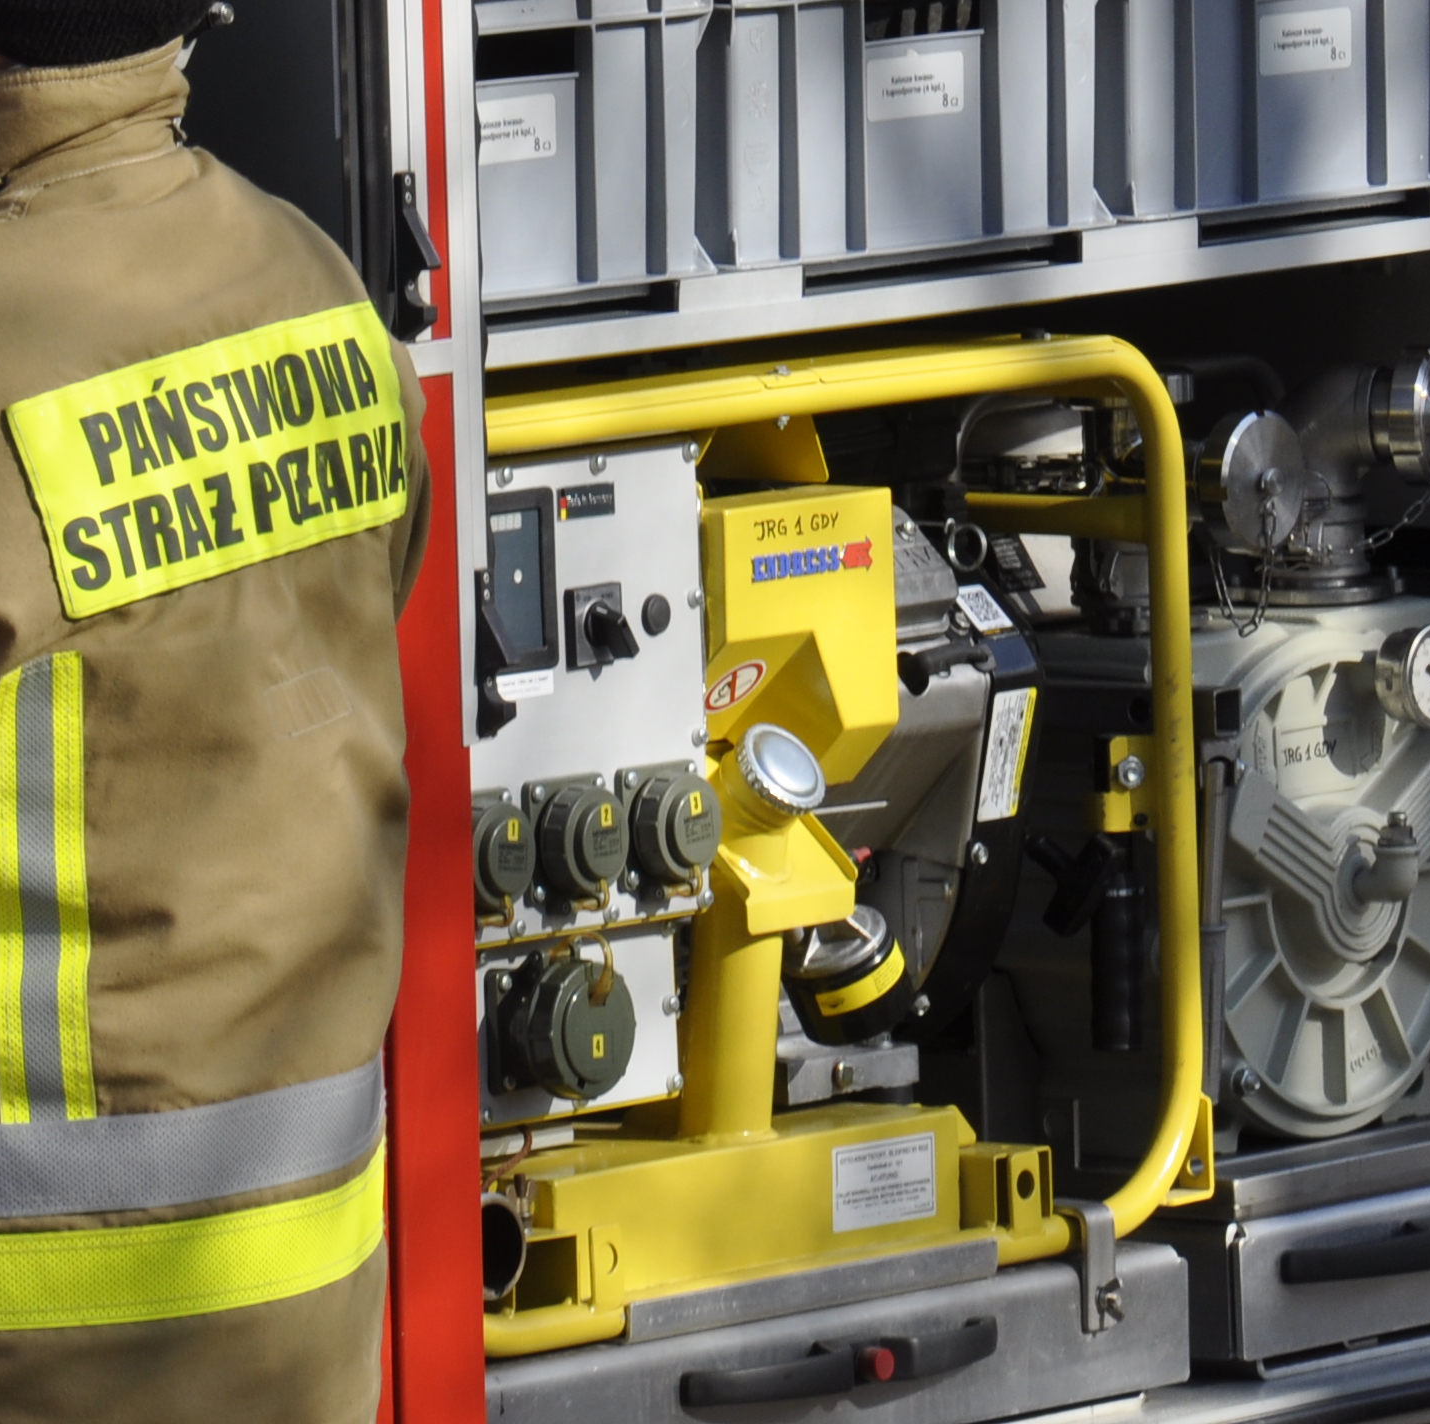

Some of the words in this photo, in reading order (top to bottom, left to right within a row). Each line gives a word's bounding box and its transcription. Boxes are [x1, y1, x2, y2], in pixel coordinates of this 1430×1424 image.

[1330, 45, 1338, 61] 8
[941, 93, 949, 109] 8
[533, 136, 541, 153] 8
[80, 337, 379, 488] PAŃSTWOWA
[62, 471, 245, 592] STRAŻ
[793, 514, 805, 536] 1
[809, 511, 840, 532] GDY
[751, 544, 841, 584] ENDRESS
[602, 806, 610, 824] 2
[595, 1038, 601, 1053] 4
